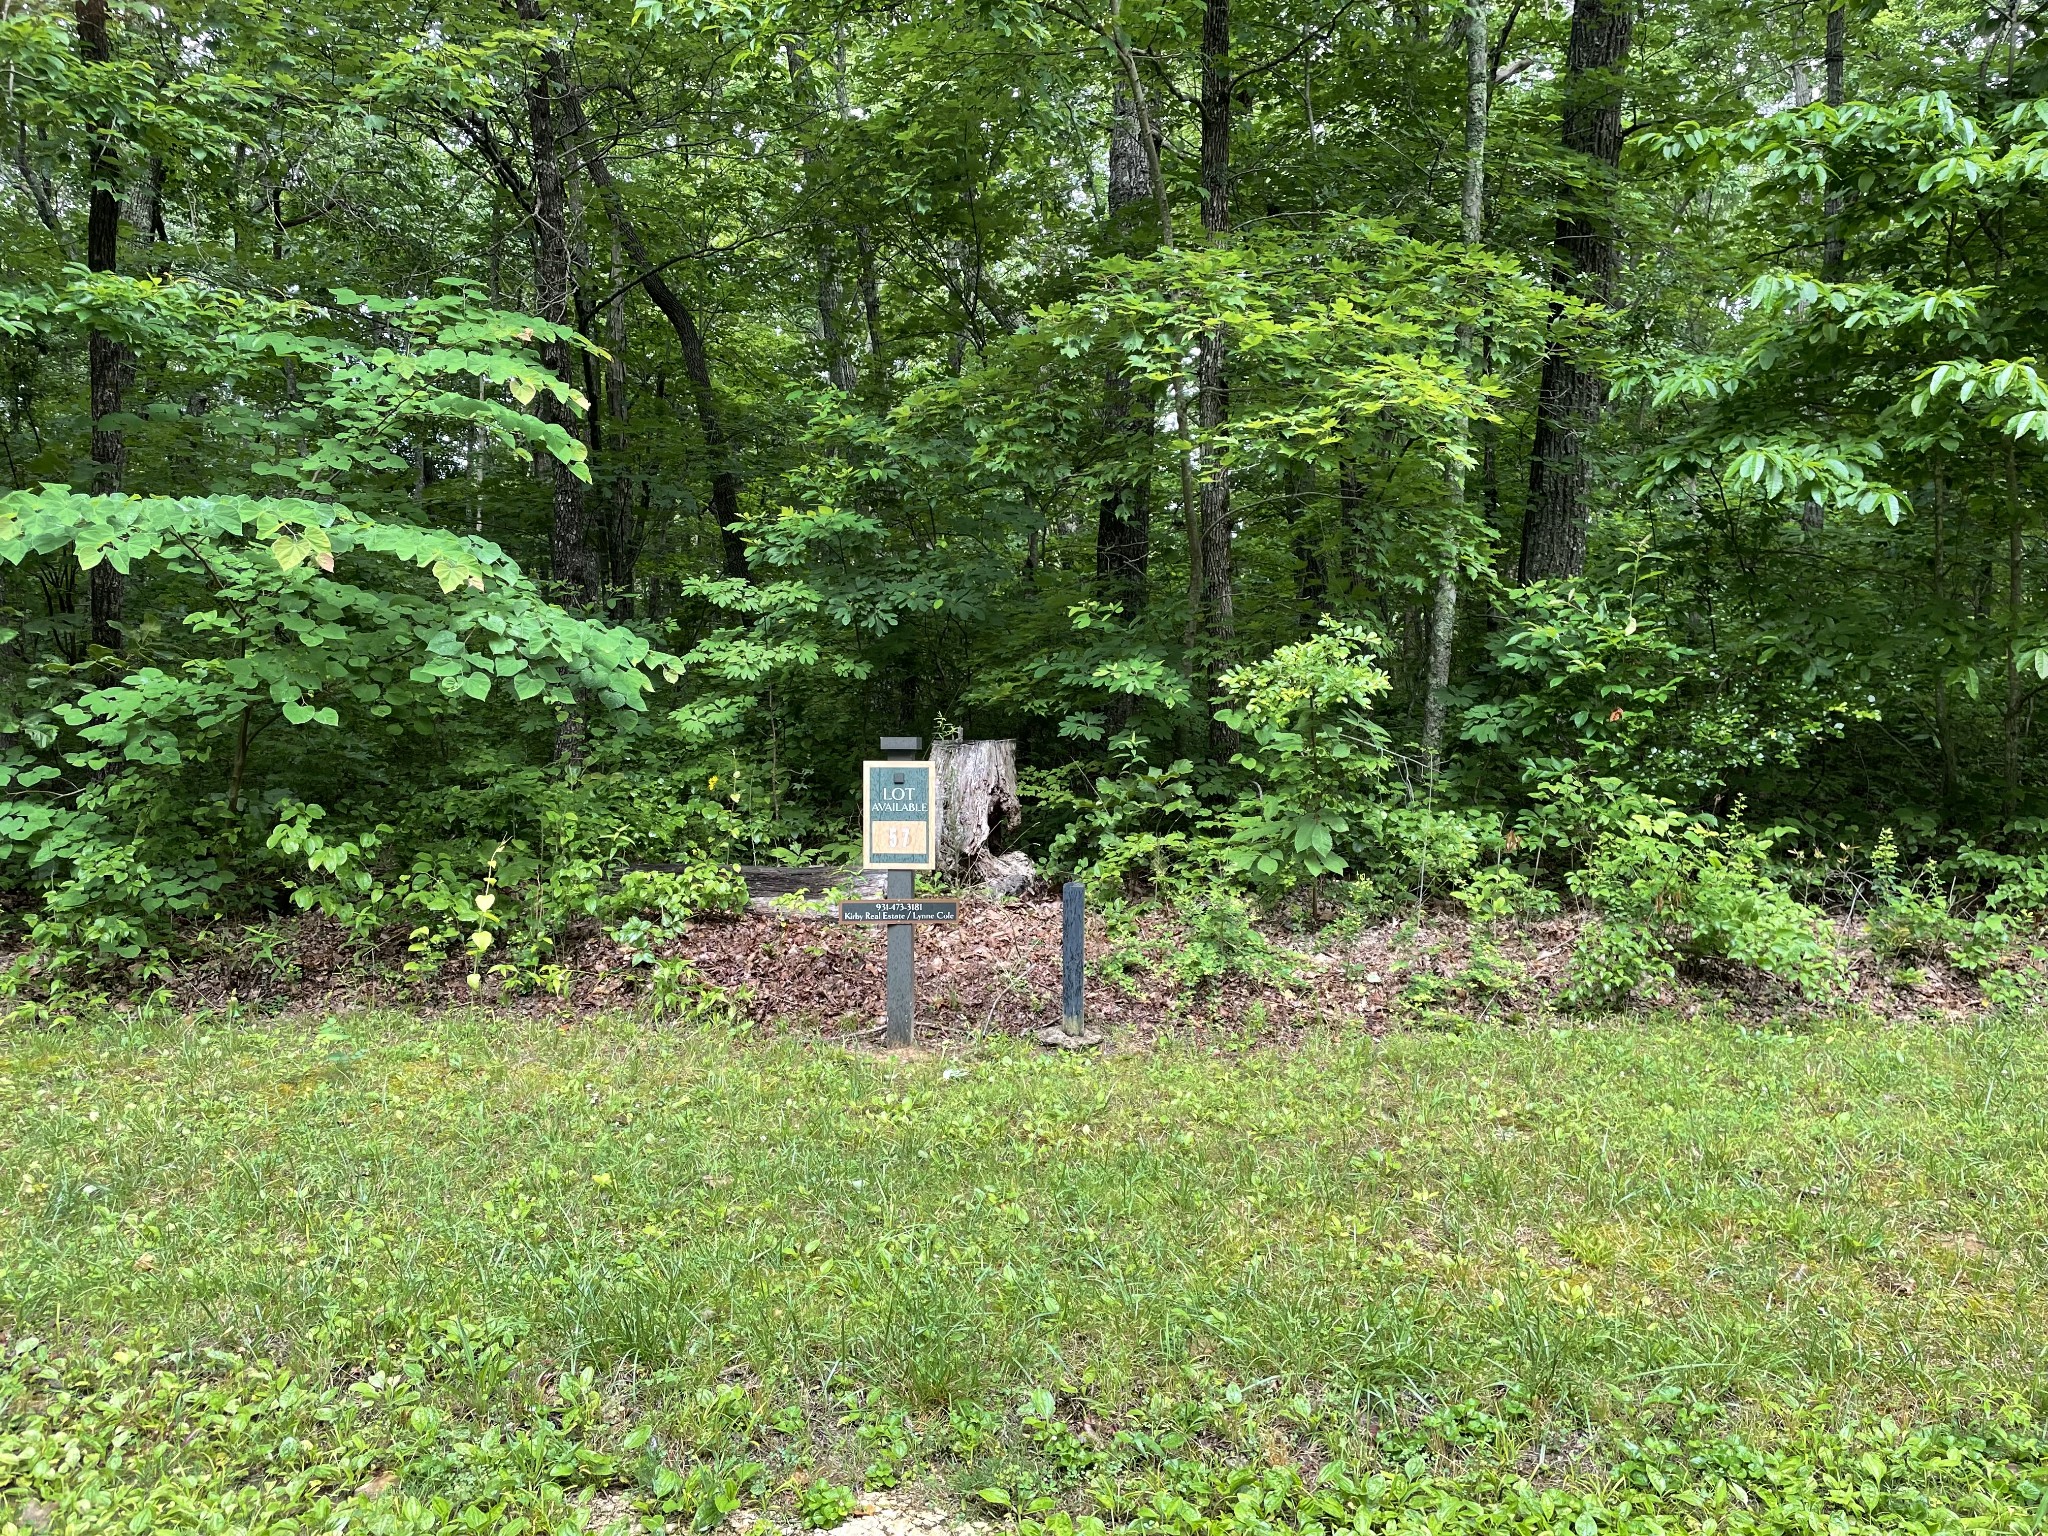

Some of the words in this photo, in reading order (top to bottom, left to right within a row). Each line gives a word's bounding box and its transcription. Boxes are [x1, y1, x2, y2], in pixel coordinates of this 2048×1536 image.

[883, 787, 916, 801] LOT
[871, 802, 928, 812] AVAILABLE
[875, 903, 923, 911] 931-473-3181
[844, 912, 863, 921] Kirby
[865, 912, 881, 920] Real
[882, 912, 906, 920] Estate
[912, 912, 934, 921] Lynne
[936, 911, 955, 920] Cole
